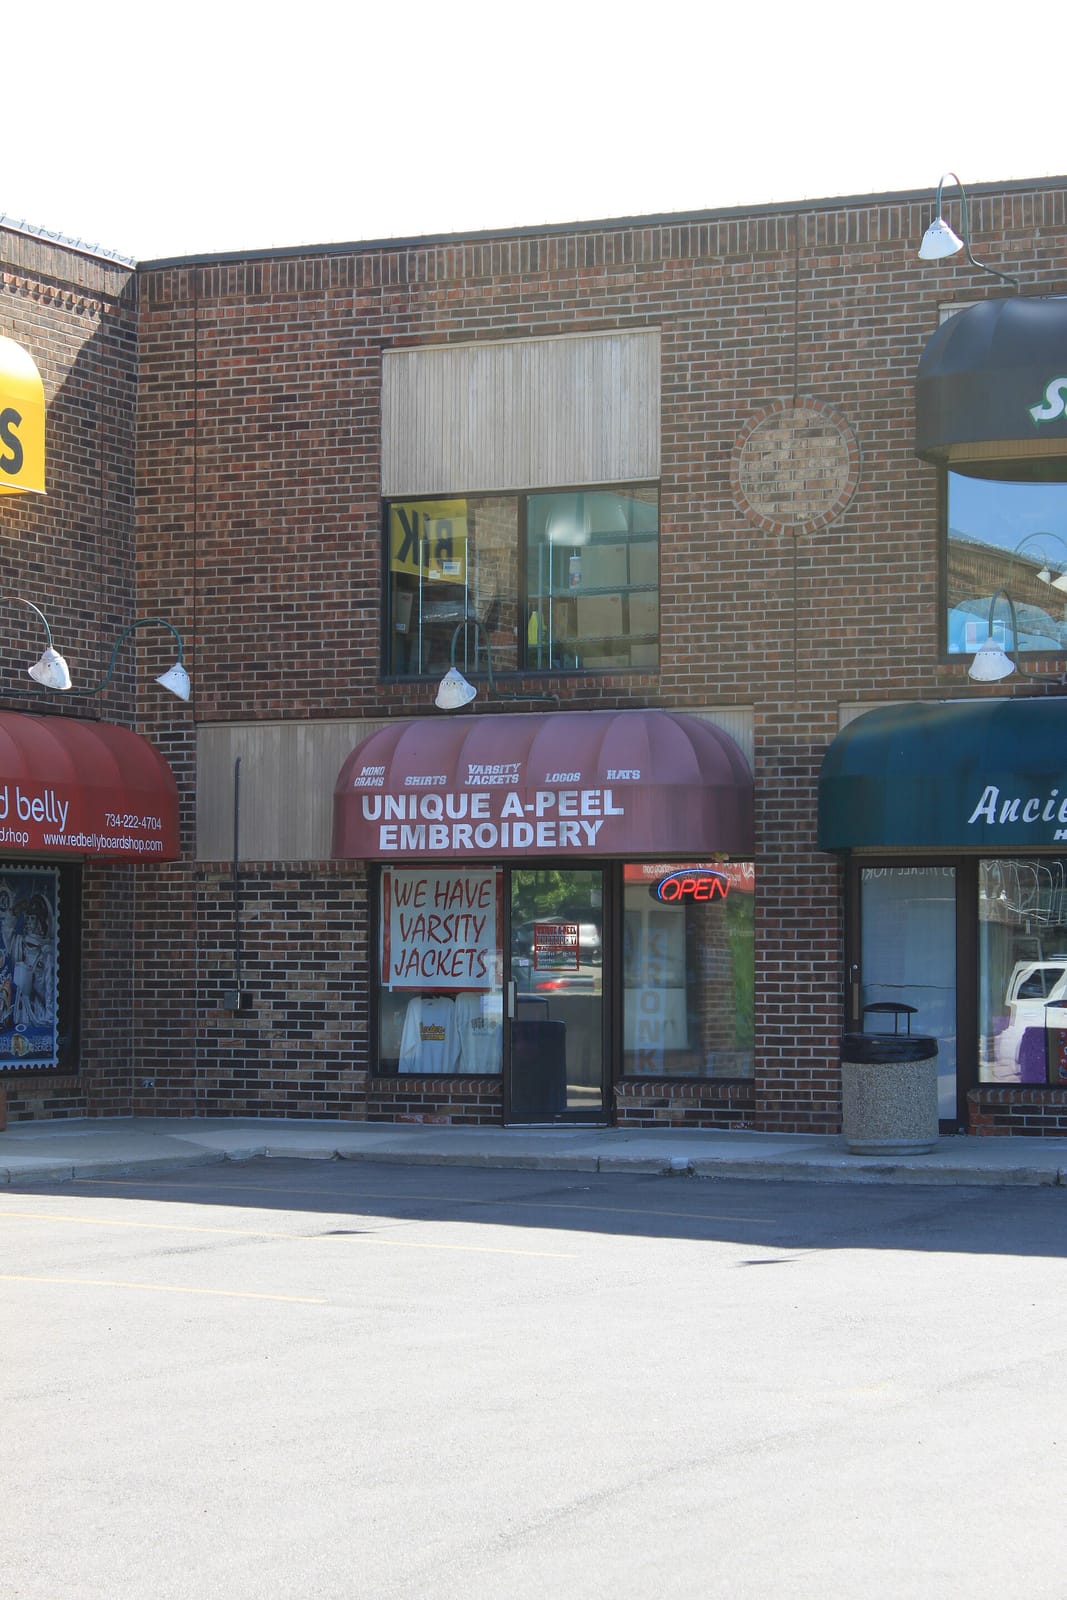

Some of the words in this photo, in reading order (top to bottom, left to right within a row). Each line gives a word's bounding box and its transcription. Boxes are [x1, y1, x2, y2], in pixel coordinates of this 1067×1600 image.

[360, 766, 385, 776] MONO
[467, 762, 521, 774] VARSITY
[544, 772, 581, 783] LOGOS
[606, 769, 641, 780] HATS
[354, 776, 385, 787] GRAMS
[404, 775, 447, 786] SHIRTS
[464, 773, 519, 785] JACKETS
[15, 786, 69, 832] belly
[362, 793, 491, 821] UNIQUE
[500, 789, 624, 818] A-PEEL
[104, 813, 162, 831] 734-222-4704
[43, 832, 163, 853] www.redbellyboardshop.com
[379, 820, 604, 850] EMBROIDERY
[394, 878, 427, 908] WE
[434, 878, 492, 910] HAVE
[661, 878, 732, 901] OPEN
[400, 913, 486, 944] VARSITY
[394, 947, 488, 978] JACKETS
